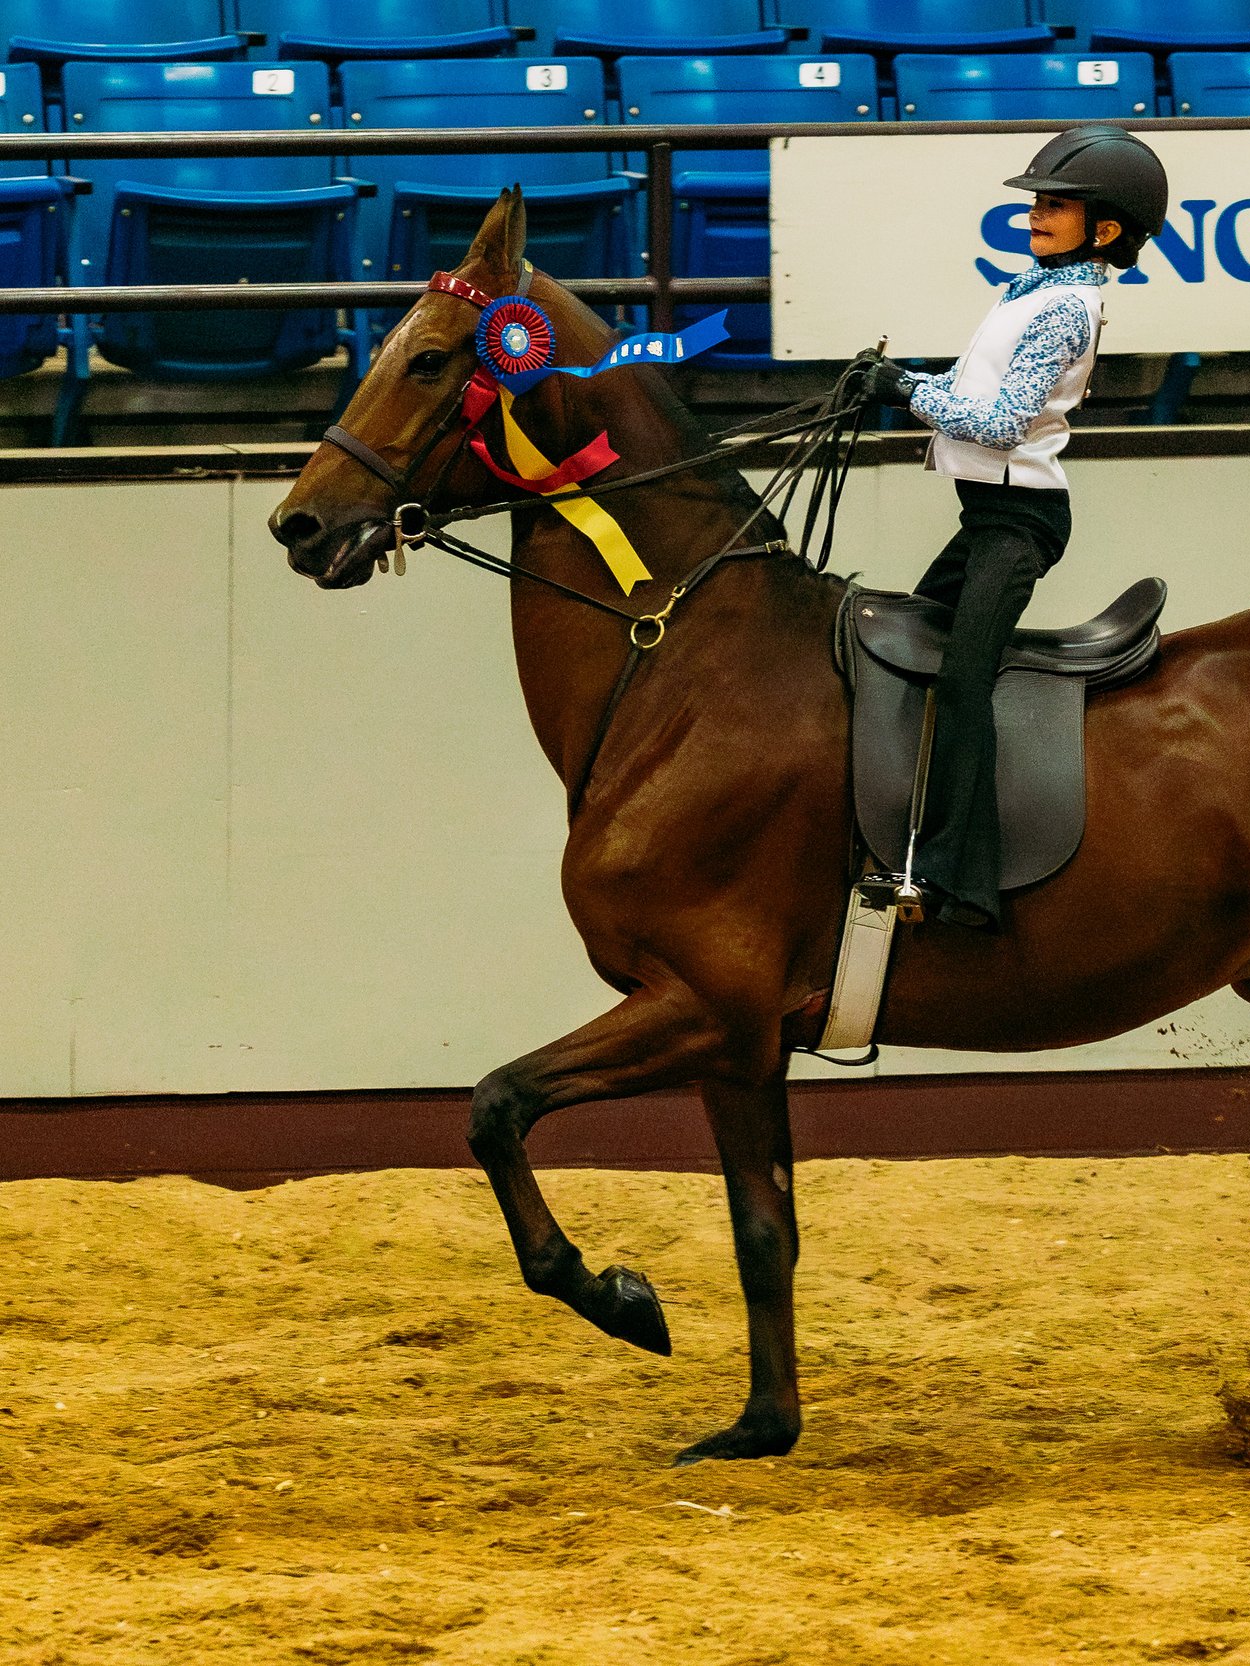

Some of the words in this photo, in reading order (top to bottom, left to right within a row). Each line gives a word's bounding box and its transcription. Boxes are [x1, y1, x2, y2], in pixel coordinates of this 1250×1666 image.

[266, 73, 278, 92] 2
[541, 68, 553, 88] 3
[814, 66, 826, 85] 4
[1092, 64, 1104, 82] 5
